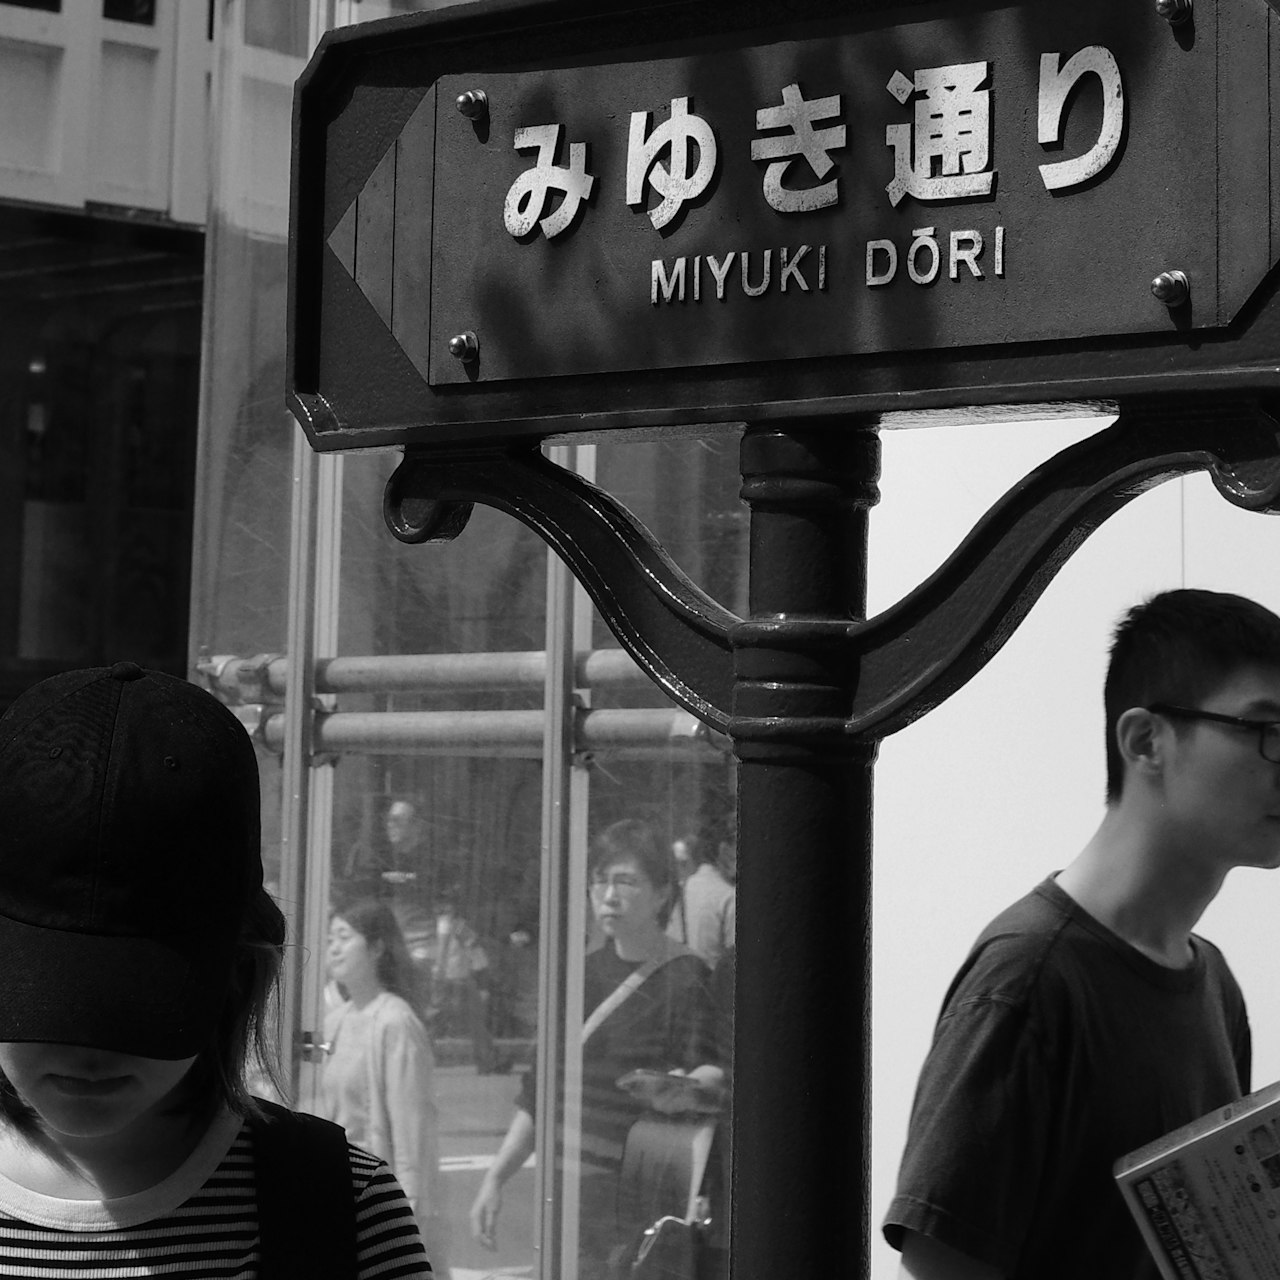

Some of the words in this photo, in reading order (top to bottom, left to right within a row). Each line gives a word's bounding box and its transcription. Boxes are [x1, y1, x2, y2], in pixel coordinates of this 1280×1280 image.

[503, 45, 1123, 240] みゆき通り
[651, 244, 827, 305] MIYUKI
[866, 227, 1006, 287] DŌRI
